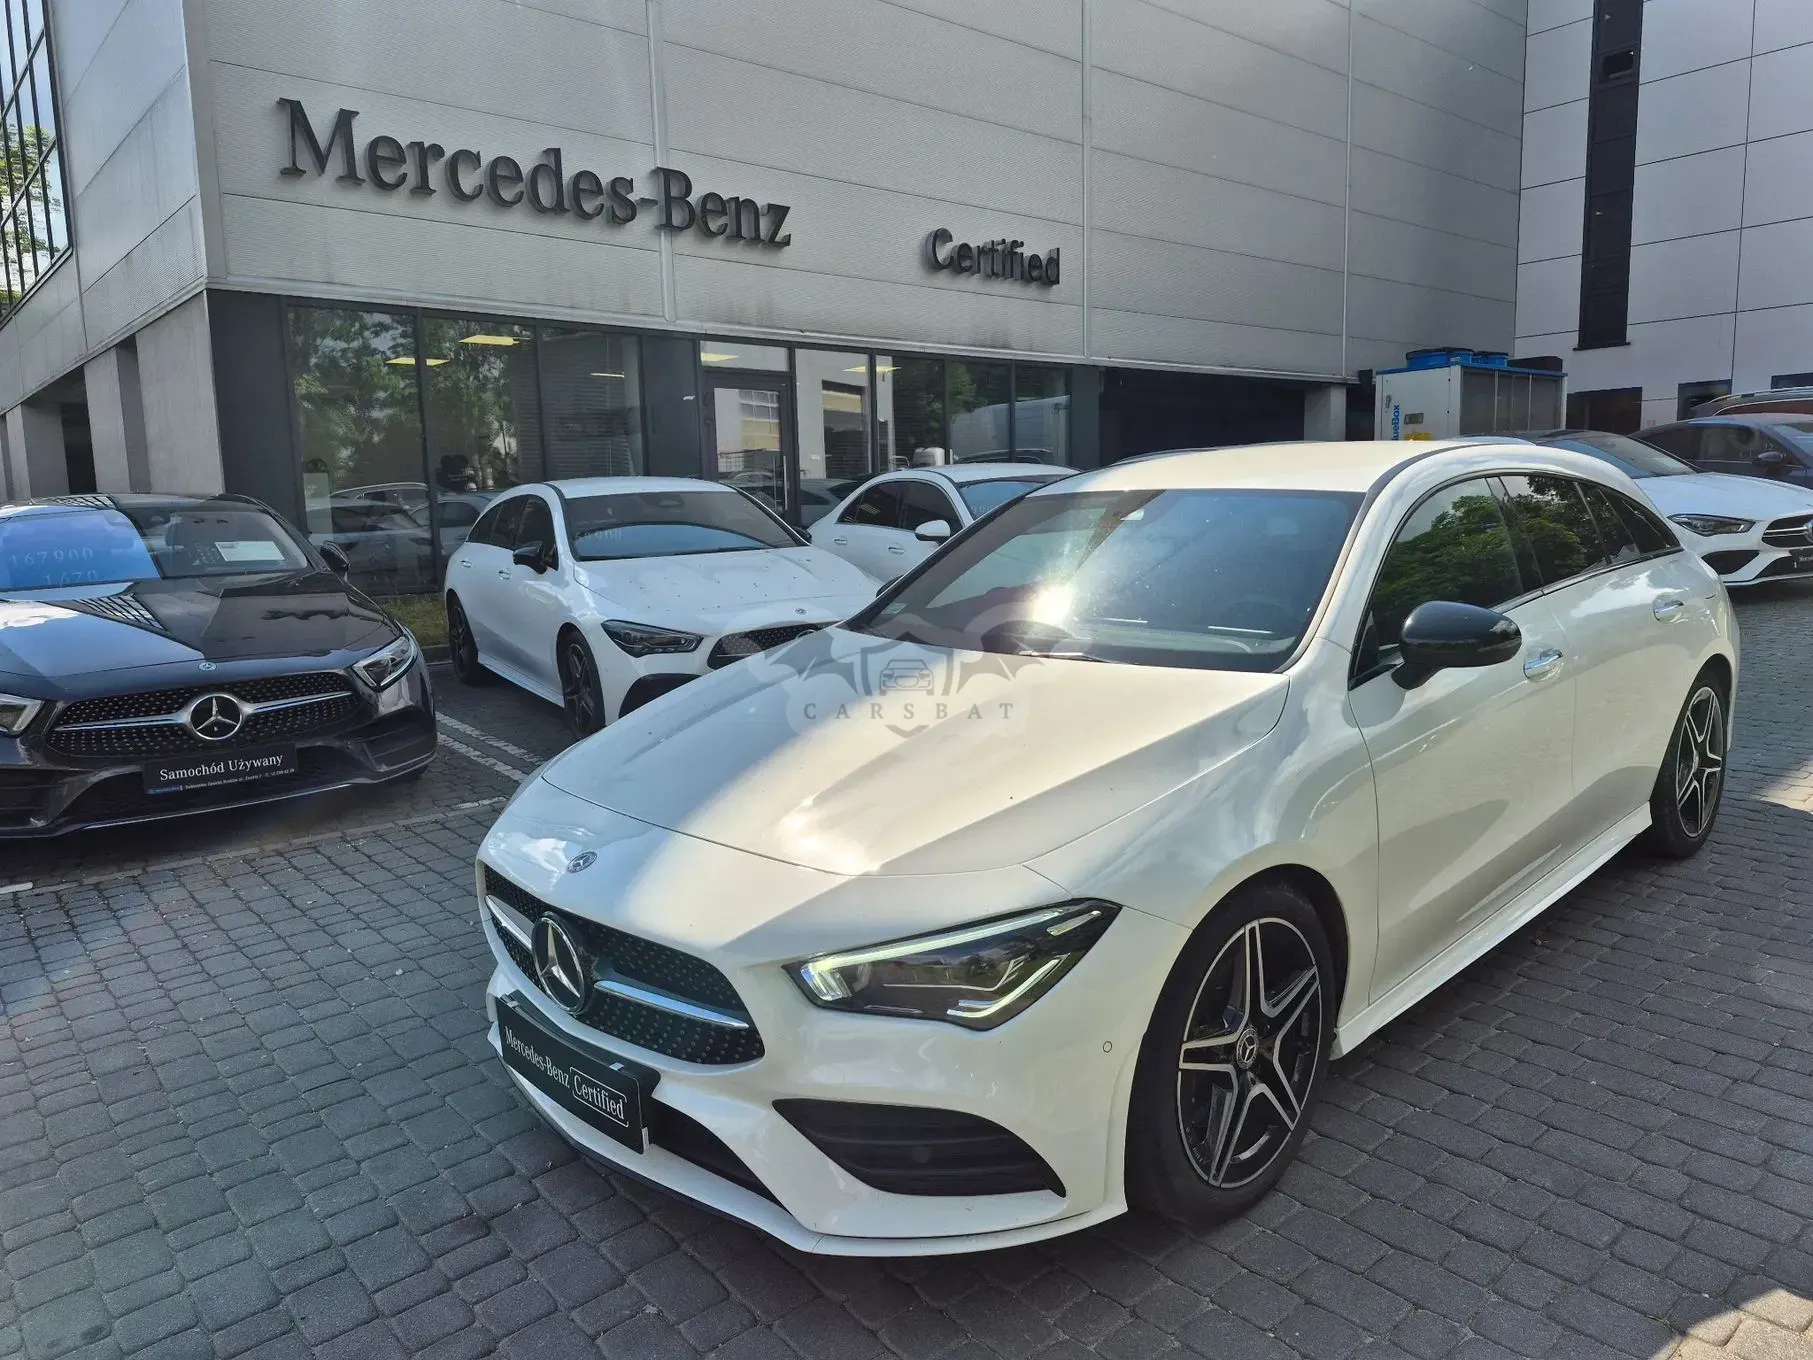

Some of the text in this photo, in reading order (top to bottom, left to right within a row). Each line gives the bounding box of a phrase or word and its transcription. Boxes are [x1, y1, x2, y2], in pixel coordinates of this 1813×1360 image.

[278, 97, 792, 248] Mercedes-Benz
[926, 227, 1061, 286] Certified
[1391, 404, 1399, 440] lueBox
[159, 761, 225, 781] Samochód
[228, 755, 283, 773] Używany
[504, 1026, 625, 1120] Mercedes-Benz Certified
